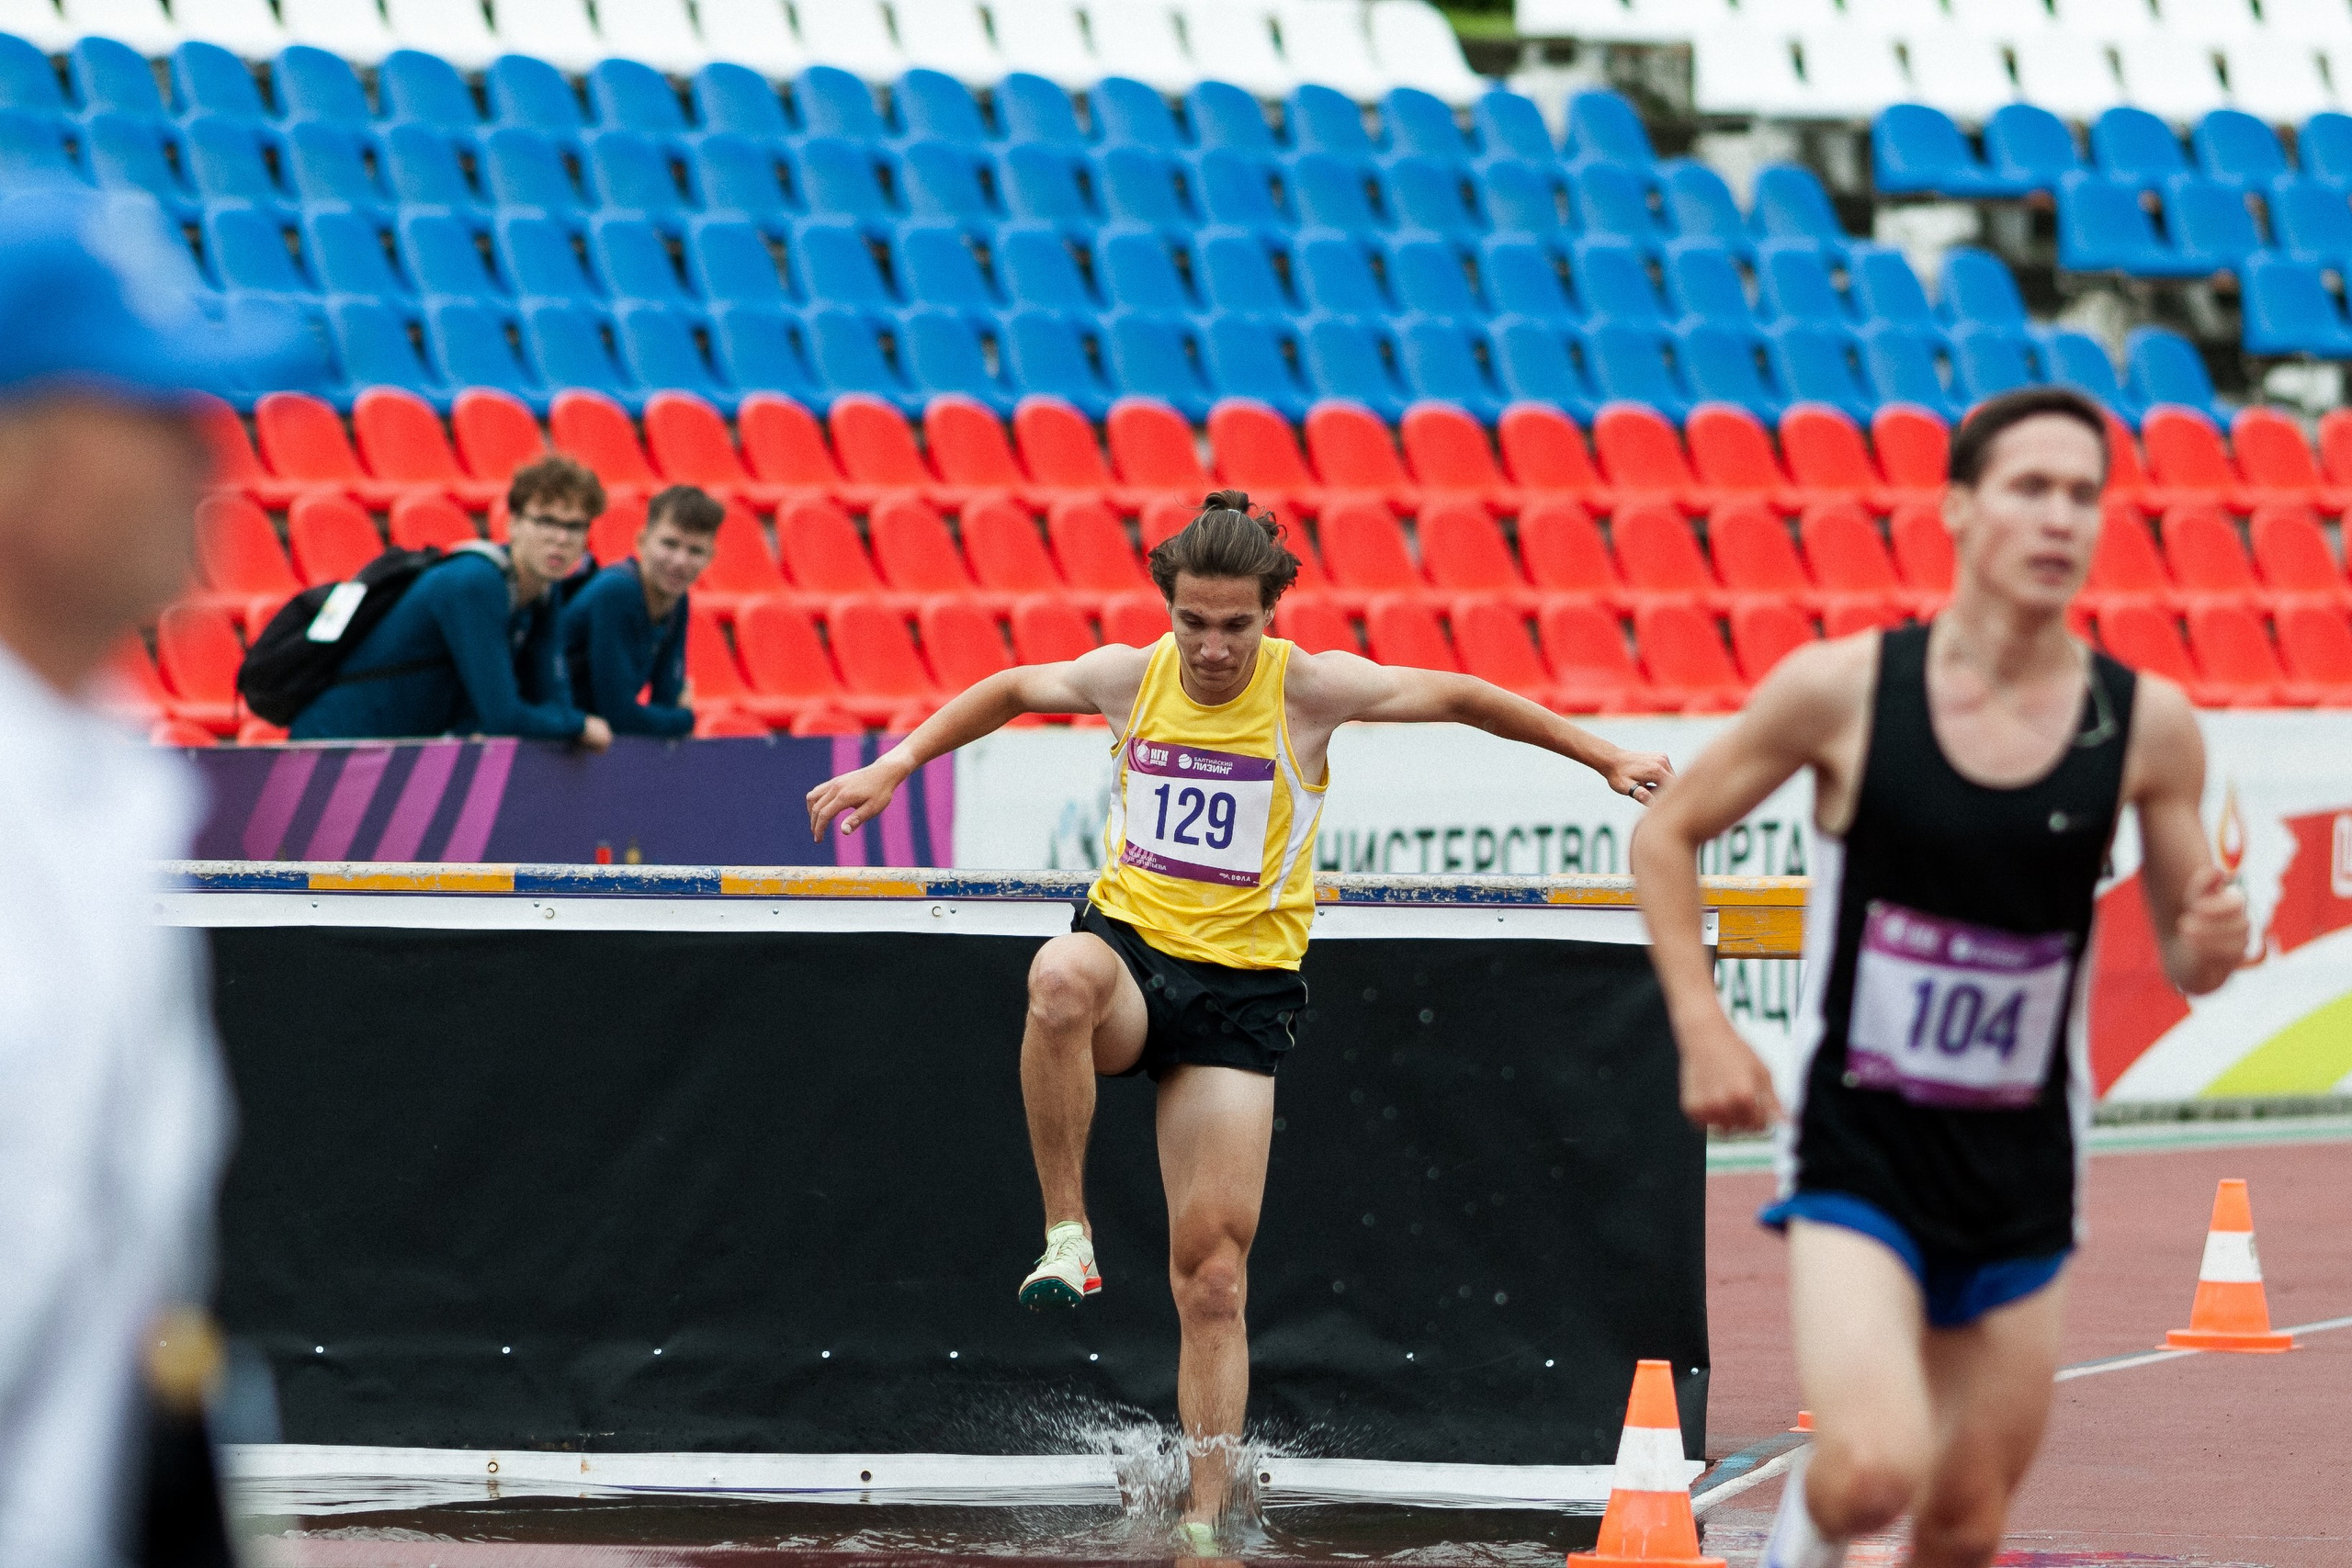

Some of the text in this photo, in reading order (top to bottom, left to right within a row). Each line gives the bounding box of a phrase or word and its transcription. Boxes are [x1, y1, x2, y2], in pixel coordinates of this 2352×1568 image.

[1150, 748, 1169, 761] НГК
[1193, 756, 1233, 767] БАЛТИЙСКИЙ
[1193, 761, 1232, 775] ЛИЗИНГ
[1155, 784, 1237, 849] 129
[1317, 824, 1617, 874] НИСТЕРСТВО
[1907, 978, 2027, 1065] 104
